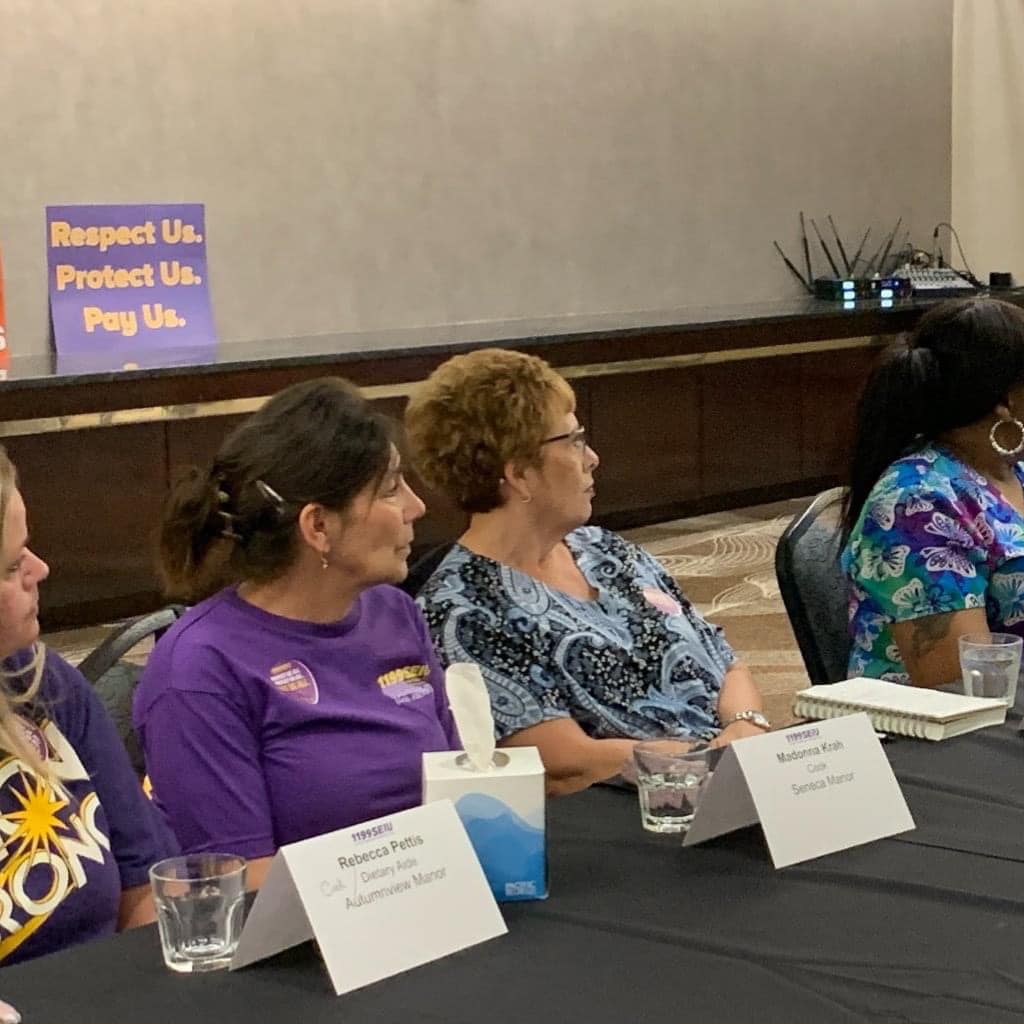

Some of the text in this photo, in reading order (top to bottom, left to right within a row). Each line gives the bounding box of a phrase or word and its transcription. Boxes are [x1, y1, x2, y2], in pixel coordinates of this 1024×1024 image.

[50, 218, 203, 252] Respect Us.
[55, 260, 202, 291] Protect Us.
[83, 303, 187, 337] Pay Us.
[337, 834, 424, 870] Rebecca Pettis
[345, 866, 448, 910] Autumnview Manor
